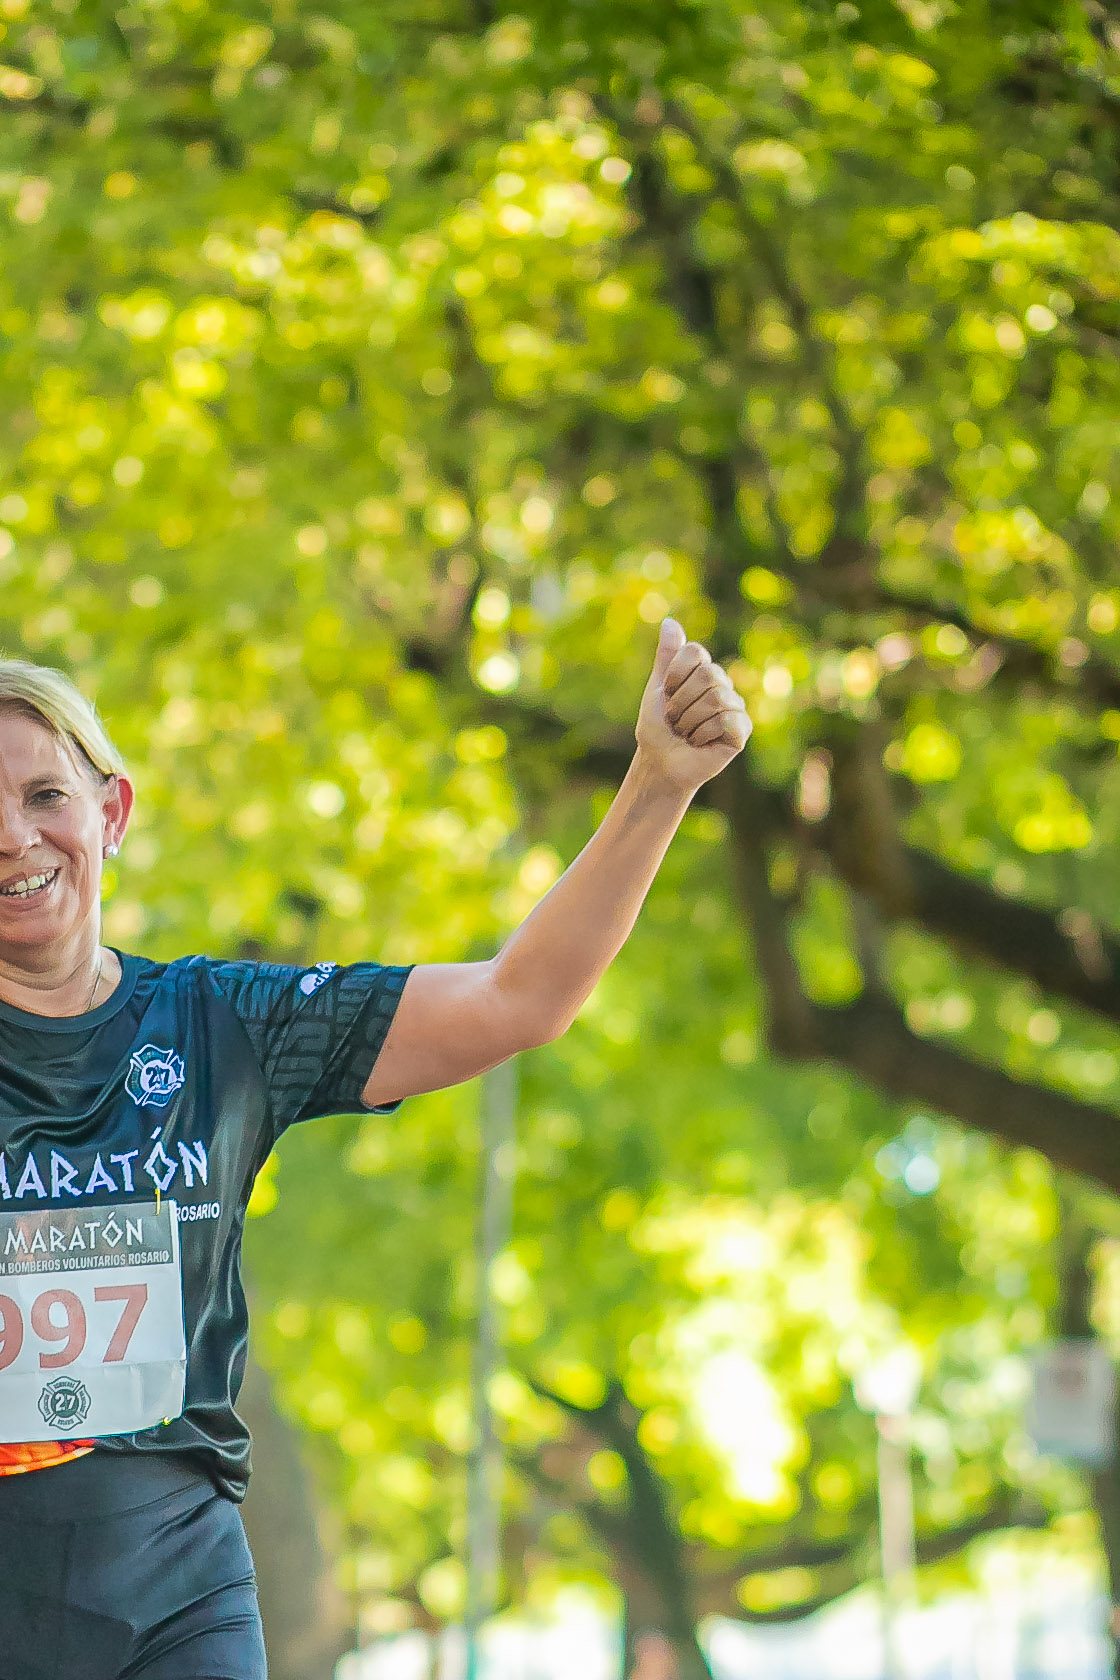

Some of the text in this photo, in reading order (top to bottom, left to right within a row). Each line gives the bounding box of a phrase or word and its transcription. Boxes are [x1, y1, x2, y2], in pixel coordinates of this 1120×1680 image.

[4, 1211, 144, 1256] MARATÓN
[8, 1258, 61, 1274] BOMBEROS
[62, 1253, 126, 1270] VOLUNTARIOS
[128, 1249, 170, 1265] ROSARIO
[54, 1392, 76, 1412] 27
